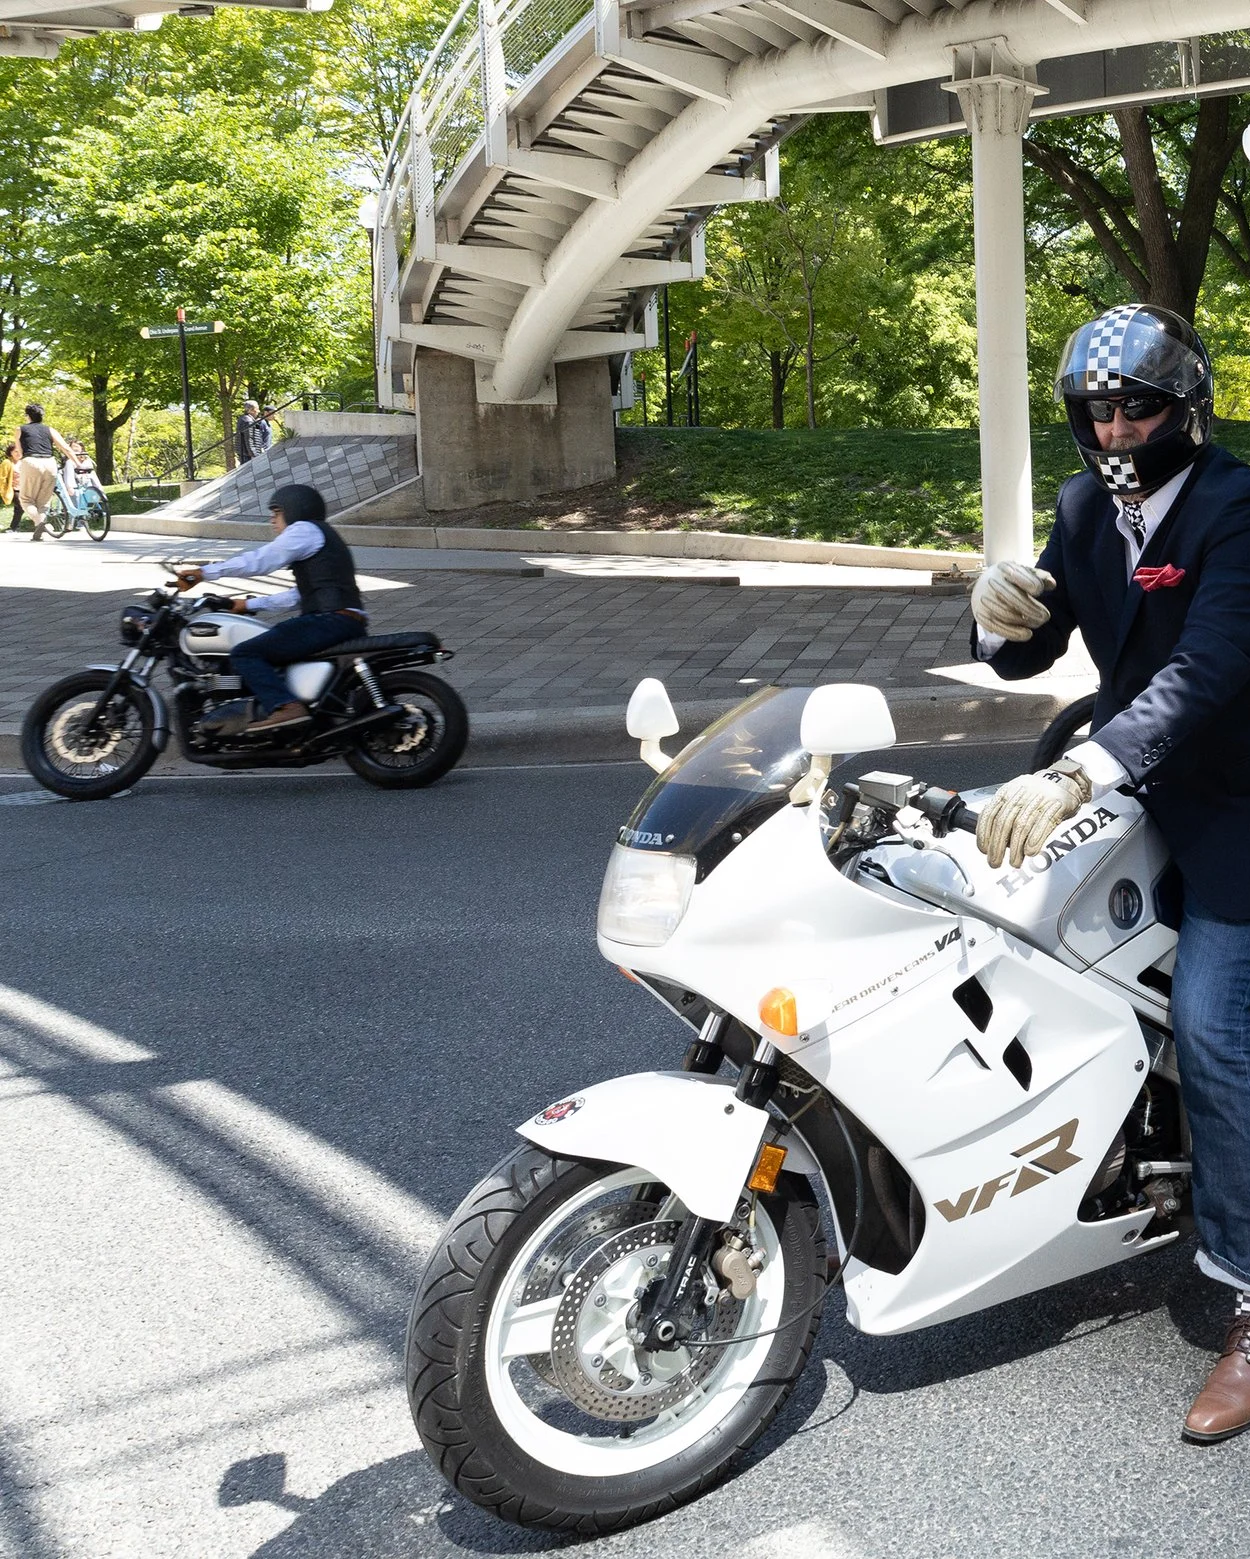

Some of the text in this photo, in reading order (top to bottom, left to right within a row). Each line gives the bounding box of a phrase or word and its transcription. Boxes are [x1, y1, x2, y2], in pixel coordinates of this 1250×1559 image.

[625, 829, 663, 846] ONDA
[996, 806, 1119, 898] HONDA
[859, 969, 904, 999] DRIVEN
[903, 950, 936, 973] CAMS
[934, 926, 962, 952] V4
[932, 1117, 1083, 1223] VFR
[675, 1256, 697, 1297] TRAC
